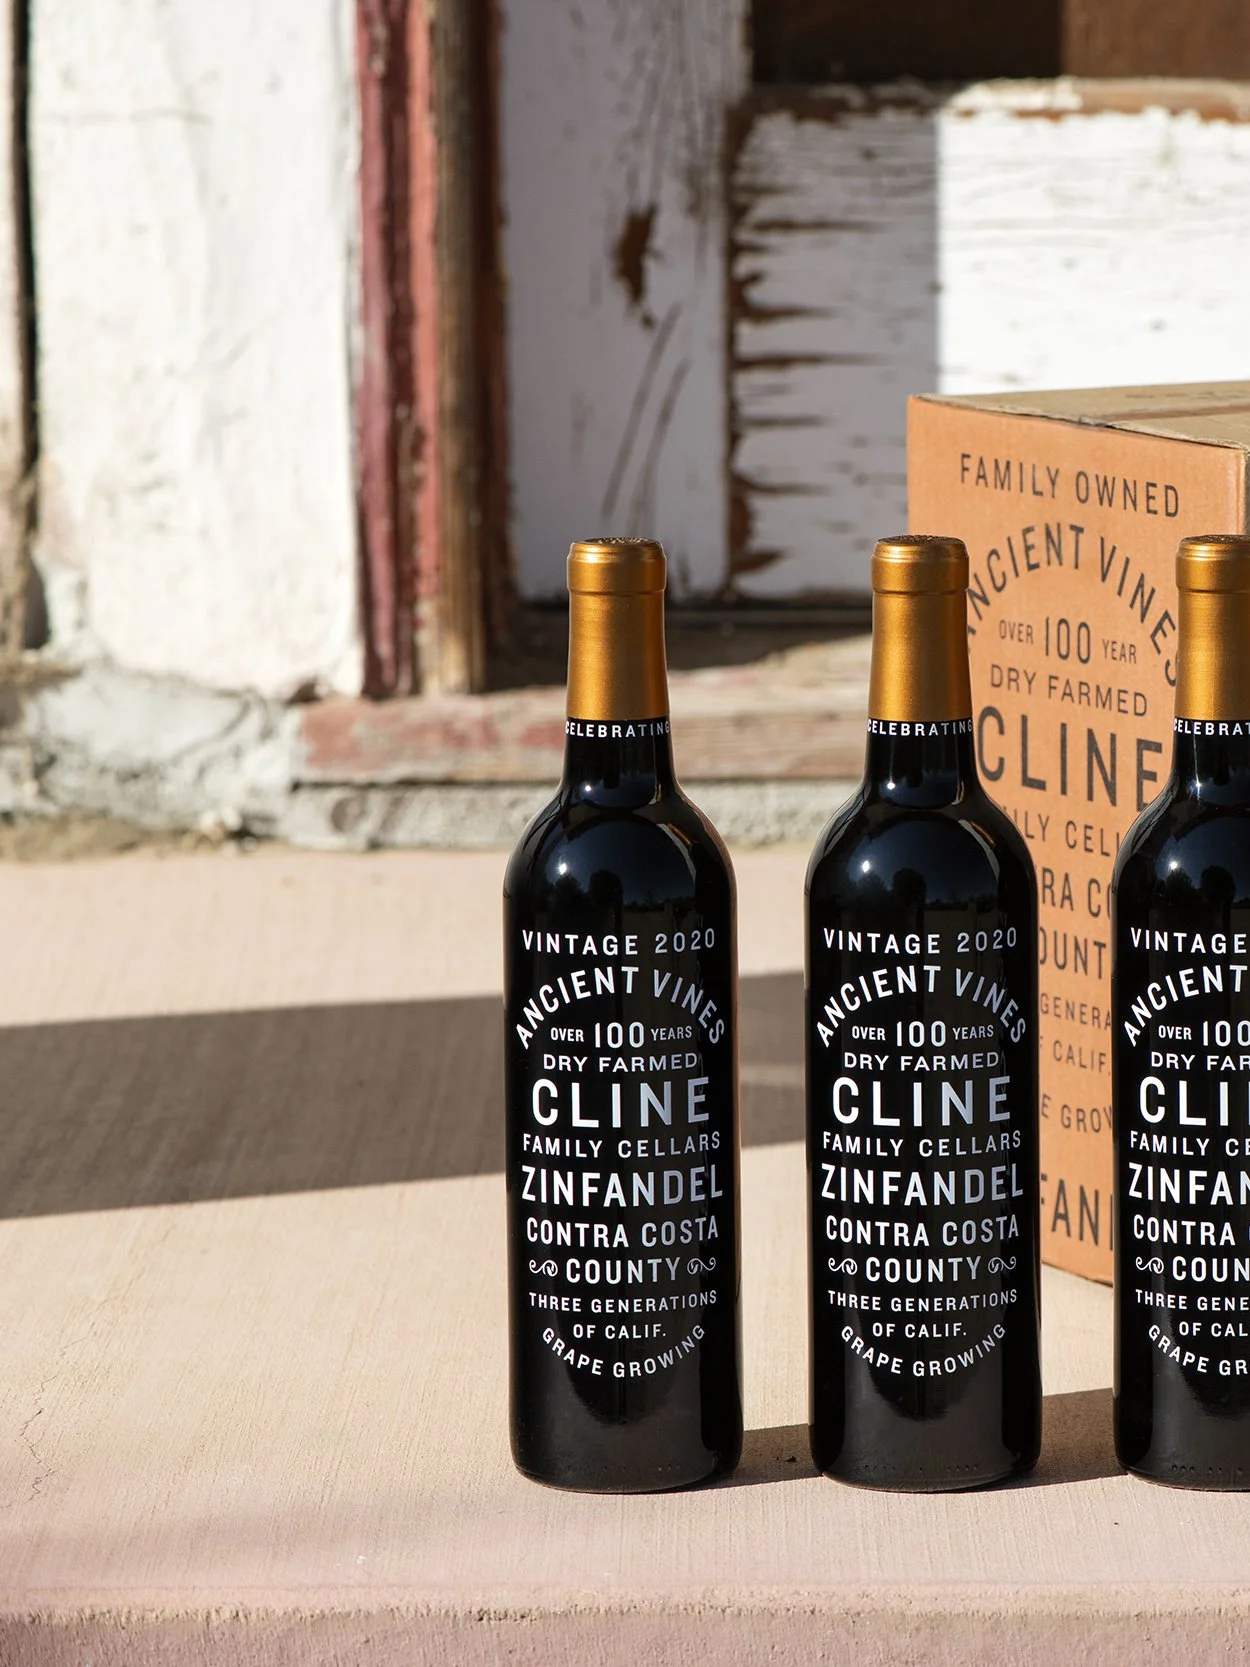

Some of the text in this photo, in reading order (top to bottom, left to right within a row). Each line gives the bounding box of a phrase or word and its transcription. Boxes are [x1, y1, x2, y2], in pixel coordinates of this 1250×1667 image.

[961, 453, 1179, 518] FAMILY OWNED
[999, 616, 1137, 665] OVER 100 YEAR
[990, 663, 1147, 717] DRY FARMED
[565, 720, 670, 738] CELEBRATING
[977, 705, 1163, 813] CLINE
[522, 927, 715, 956] VINTAGE 2020
[823, 927, 1017, 954] VINTAGE 2020
[1130, 927, 1247, 954] VINTAGE
[515, 966, 725, 1049] ANCIENT VINES
[816, 965, 1026, 1047] ANCIENT VINES
[1123, 965, 1248, 1047] ANCIENT
[550, 1021, 692, 1048] OVER 100 YEARS
[852, 1020, 994, 1047] OVER 100 YEARS
[1158, 1024, 1192, 1040] OVER
[543, 1052, 698, 1073] DRY FARMED
[844, 1051, 999, 1071] DRY FARMED
[1053, 1039, 1111, 1076] CALIF.
[1151, 1051, 1195, 1070] DRY
[532, 1077, 709, 1128] CLINE
[832, 1075, 1010, 1127] CLINE
[523, 1131, 720, 1158] FAMILY CELLARS
[823, 1130, 1021, 1157] FAMILY CELLARS
[1130, 1130, 1210, 1156] FAMILY
[521, 1164, 723, 1207] ZINFANDEL
[821, 1163, 1023, 1206] ZINFANDEL
[526, 1215, 719, 1248] CONTRA COSTA
[826, 1214, 1019, 1247] CONTRA COSTA
[1133, 1214, 1236, 1246] CONTRA
[566, 1257, 680, 1284] COUNTY
[865, 1255, 981, 1283] COUNTY
[529, 1289, 717, 1313] THREE GENERATIONS
[828, 1289, 1017, 1312] THREE GENERATIONS
[1135, 1289, 1188, 1310] THREE
[573, 1323, 666, 1339] OF CALIF.
[872, 1322, 967, 1338] OF CALIF.
[1179, 1321, 1202, 1336] OF
[542, 1324, 705, 1378] GRAPE GROWING
[841, 1323, 1006, 1377] GRAPE GROWING
[1148, 1324, 1210, 1373] GRAPE
